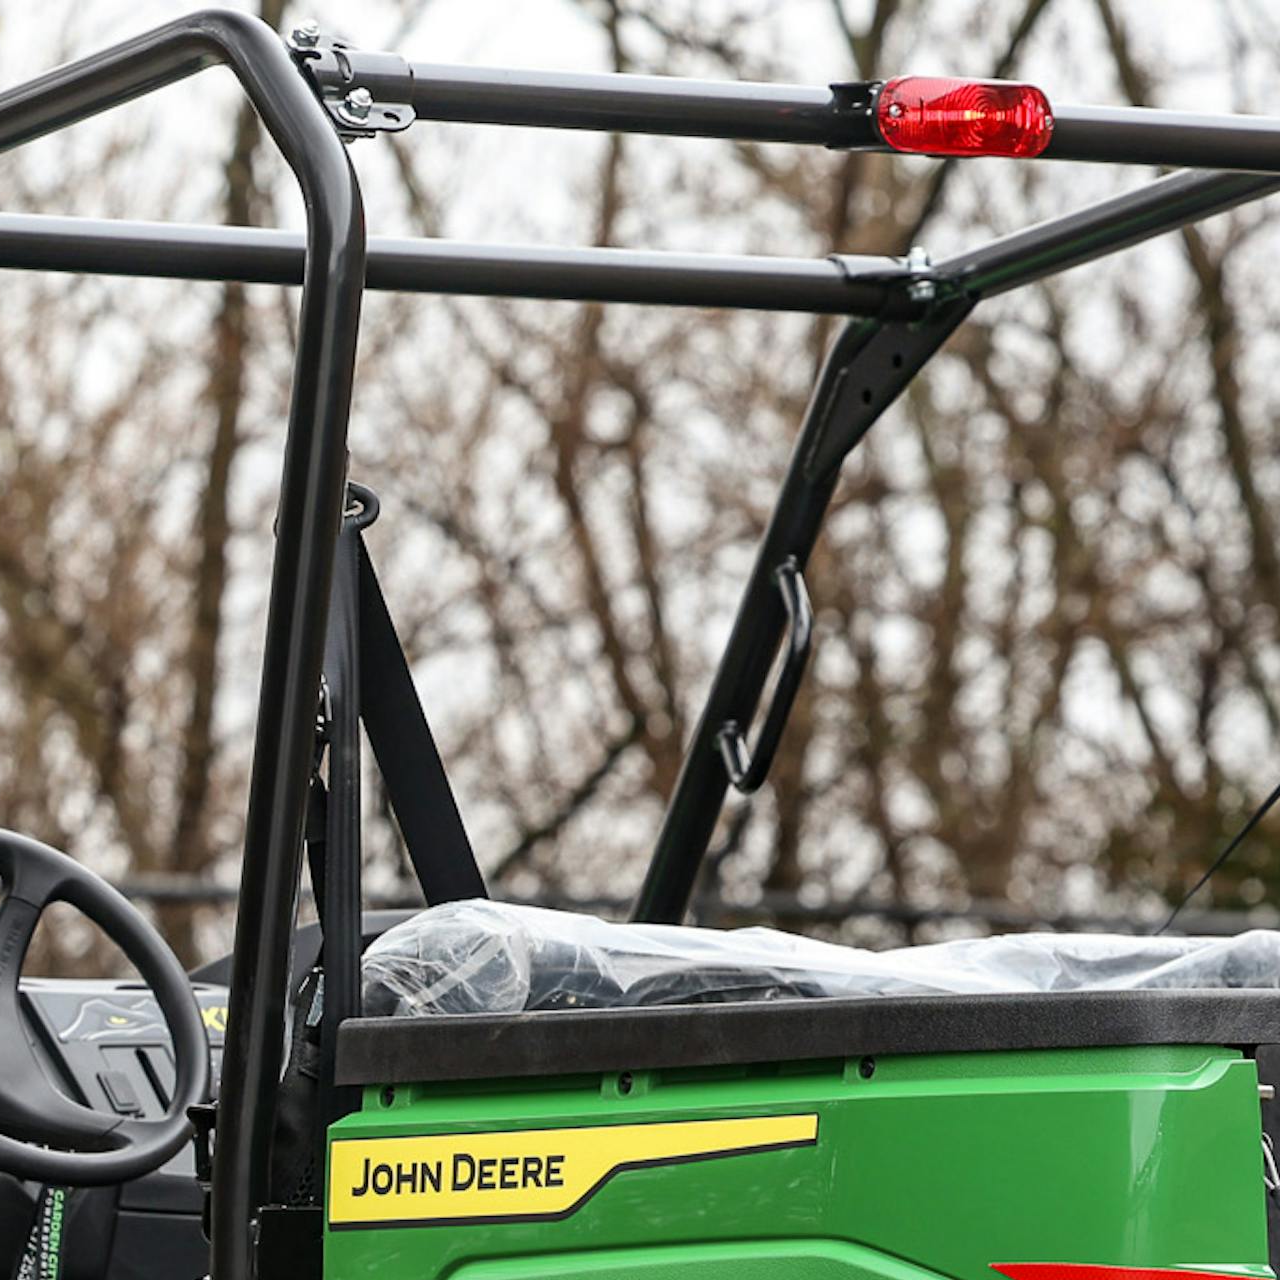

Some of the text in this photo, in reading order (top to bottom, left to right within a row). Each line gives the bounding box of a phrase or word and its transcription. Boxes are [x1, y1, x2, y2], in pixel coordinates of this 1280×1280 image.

[352, 1153, 565, 1197] JOHN DEERE
[48, 1190, 64, 1252] GARDEN
